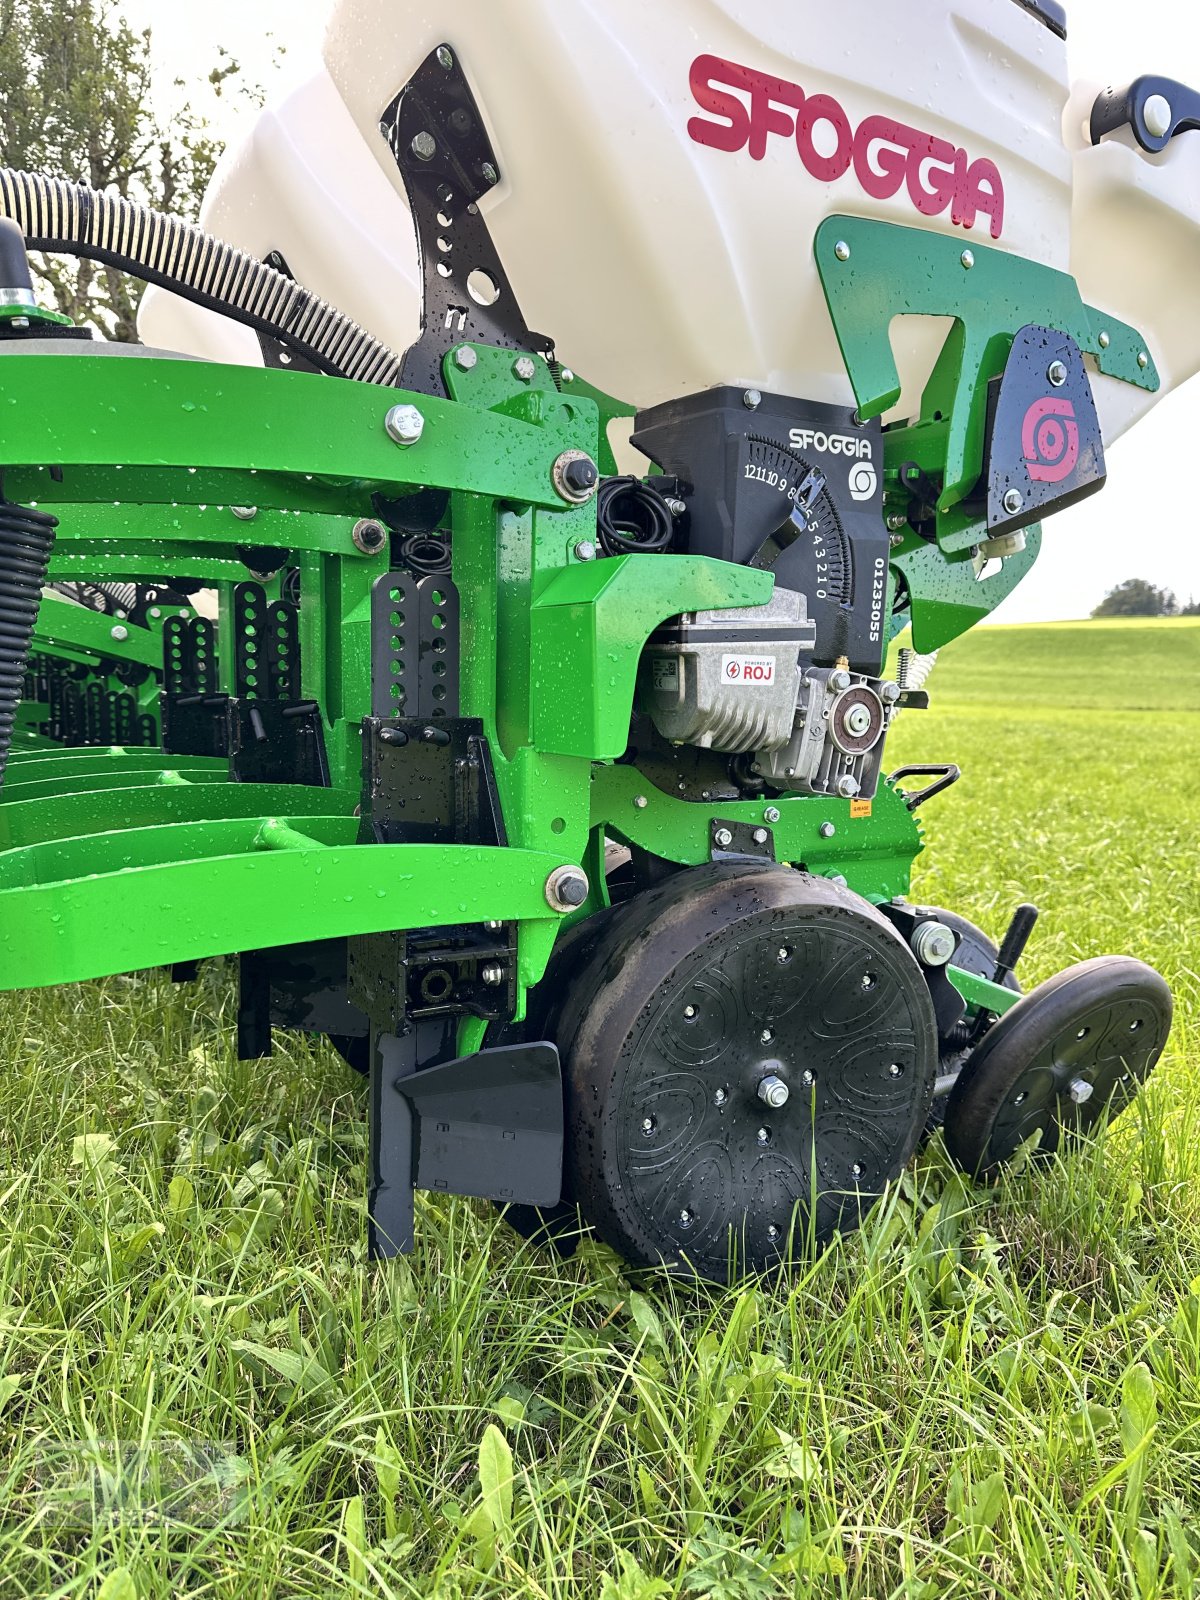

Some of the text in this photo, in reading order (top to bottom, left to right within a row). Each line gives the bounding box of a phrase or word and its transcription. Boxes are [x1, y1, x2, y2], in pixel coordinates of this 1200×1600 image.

[687, 53, 1005, 240] SFOGGIA
[788, 428, 872, 460] SFOGGIA
[744, 464, 756, 479] 12
[755, 466, 767, 482] 11
[766, 471, 778, 486] 10
[778, 479, 787, 491] 9
[787, 487, 796, 500] 8
[808, 521, 819, 532] 5
[813, 535, 823, 545] 4
[815, 549, 826, 558] 3
[816, 563, 827, 573] 2
[817, 576, 828, 584] 1
[816, 589, 827, 599] 0
[869, 557, 885, 642] 01233055
[743, 665, 772, 680] ROJ
